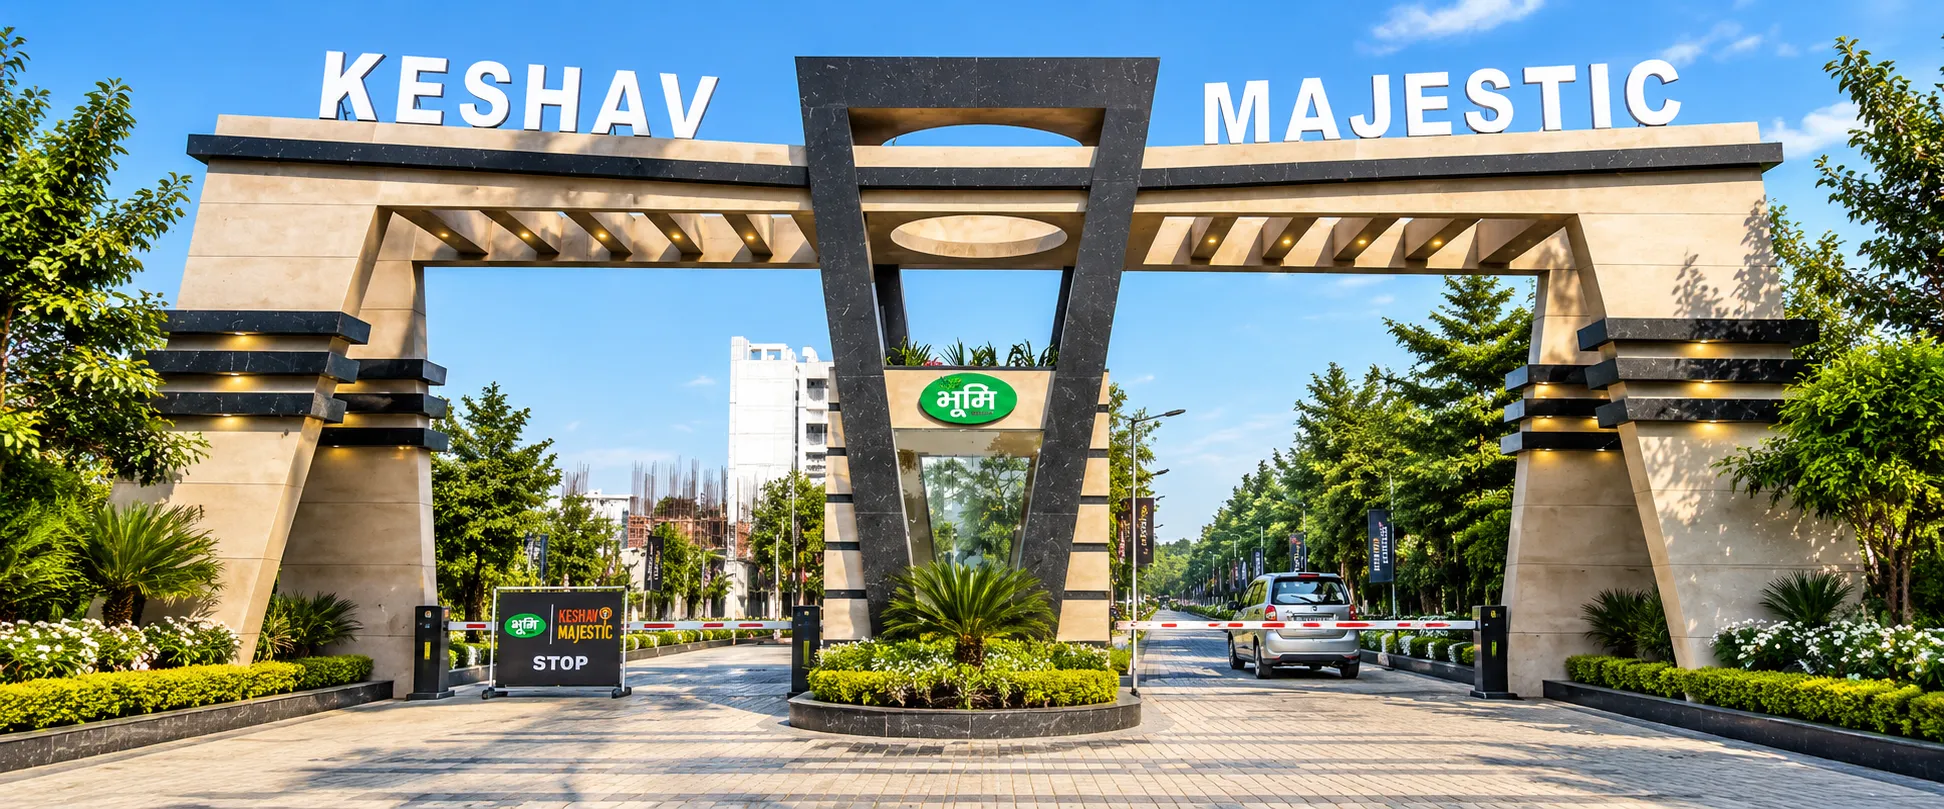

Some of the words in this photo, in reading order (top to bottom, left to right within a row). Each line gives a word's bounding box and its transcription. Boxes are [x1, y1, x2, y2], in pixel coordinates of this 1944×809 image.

[318, 50, 720, 139] KESHAV
[1203, 59, 1682, 145] MAJESTIC
[936, 383, 998, 418] भूमि
[558, 609, 598, 623] KESHAV
[557, 625, 612, 643] MAJESTIC
[532, 655, 588, 671] STOP
